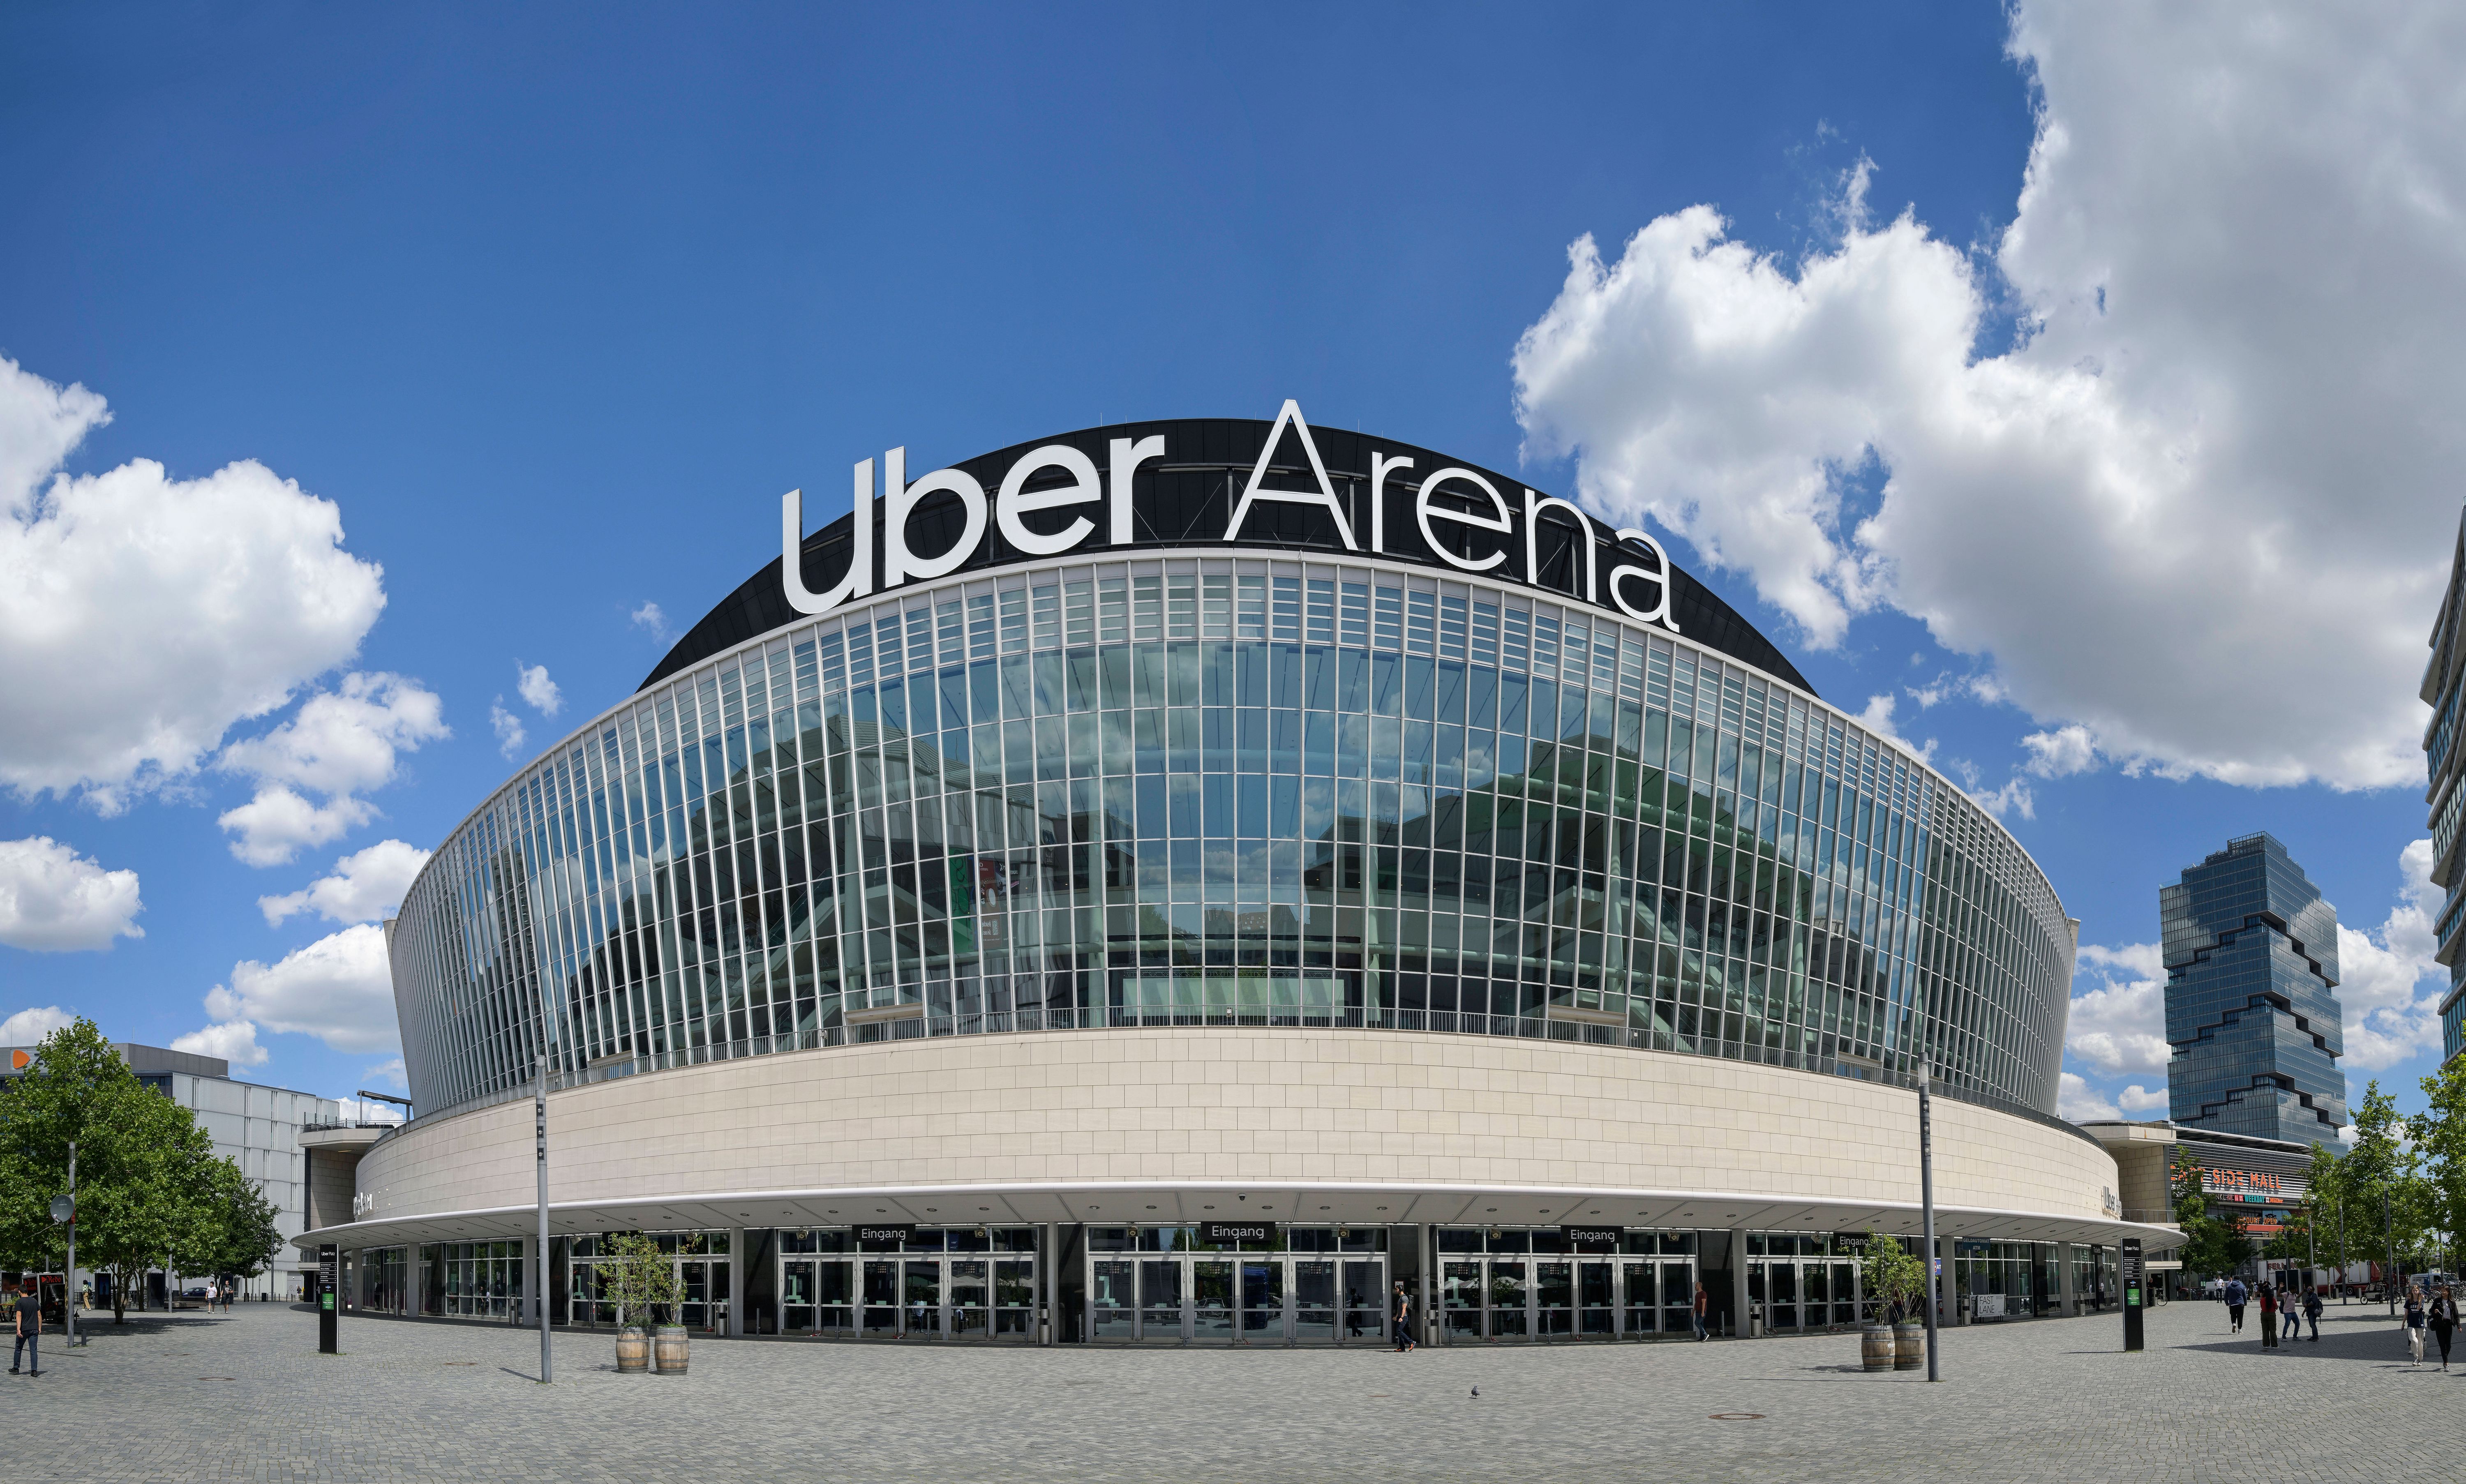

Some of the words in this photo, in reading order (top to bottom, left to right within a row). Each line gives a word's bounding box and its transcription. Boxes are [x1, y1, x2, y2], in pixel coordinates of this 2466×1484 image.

[782, 433, 1165, 615] Uber
[1223, 398, 1679, 633] Arena
[2212, 1169, 2244, 1186] SIDE
[2250, 1172, 2281, 1189] MALL
[2244, 1195, 2265, 1204] WEEKDAY
[861, 1228, 906, 1241] Eingang
[1212, 1225, 1264, 1239] Eingang
[1570, 1229, 1615, 1242] Eingang
[1840, 1236, 1869, 1247] Eingang
[1980, 1296, 1993, 1304] FAST
[1979, 1305, 1995, 1313] LANE
